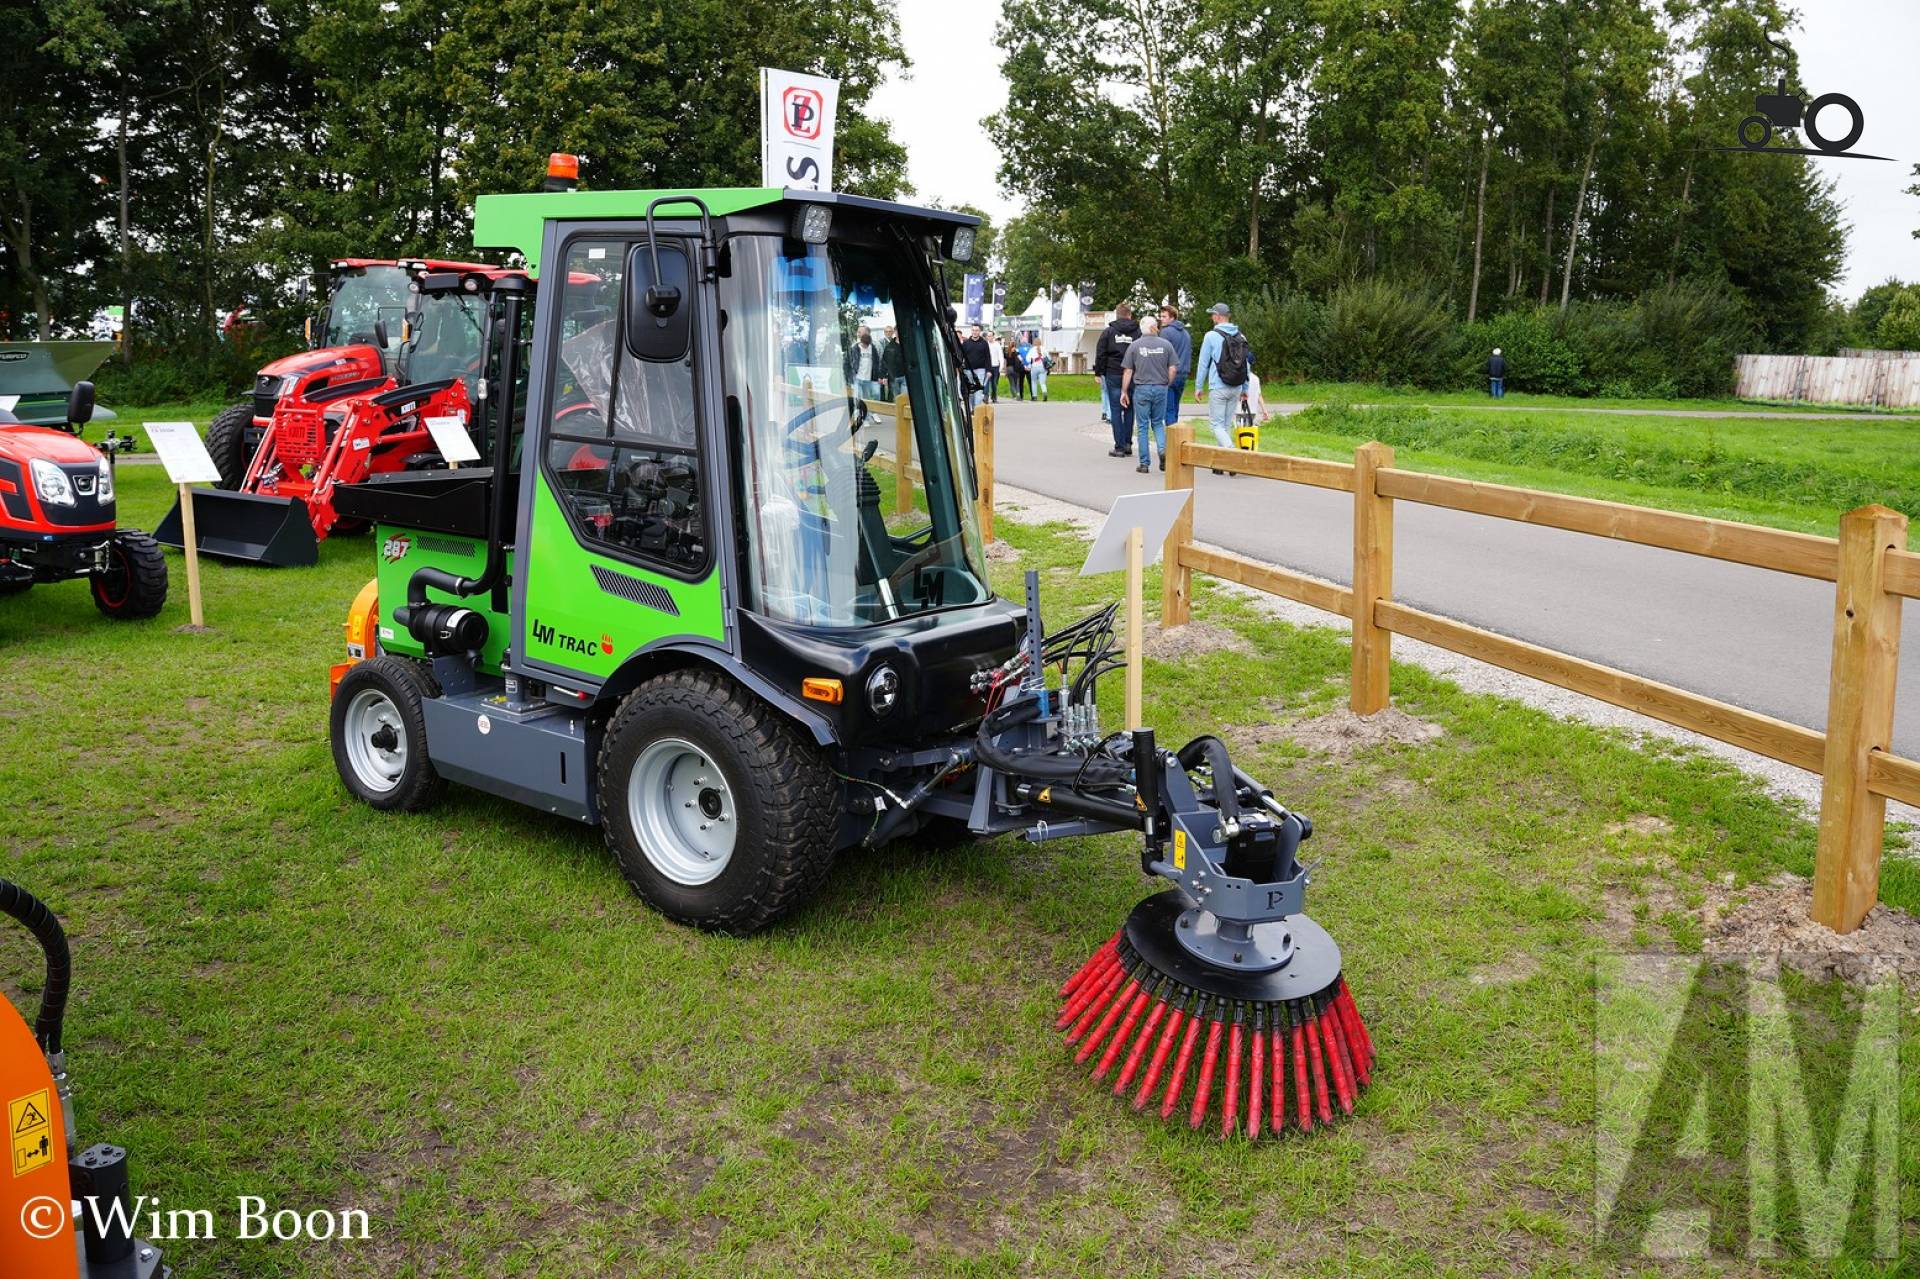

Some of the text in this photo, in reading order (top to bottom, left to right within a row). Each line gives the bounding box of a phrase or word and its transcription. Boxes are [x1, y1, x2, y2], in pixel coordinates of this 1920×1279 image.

[383, 539, 411, 559] 287
[913, 563, 945, 610] LM
[532, 618, 598, 657] LM TRAC
